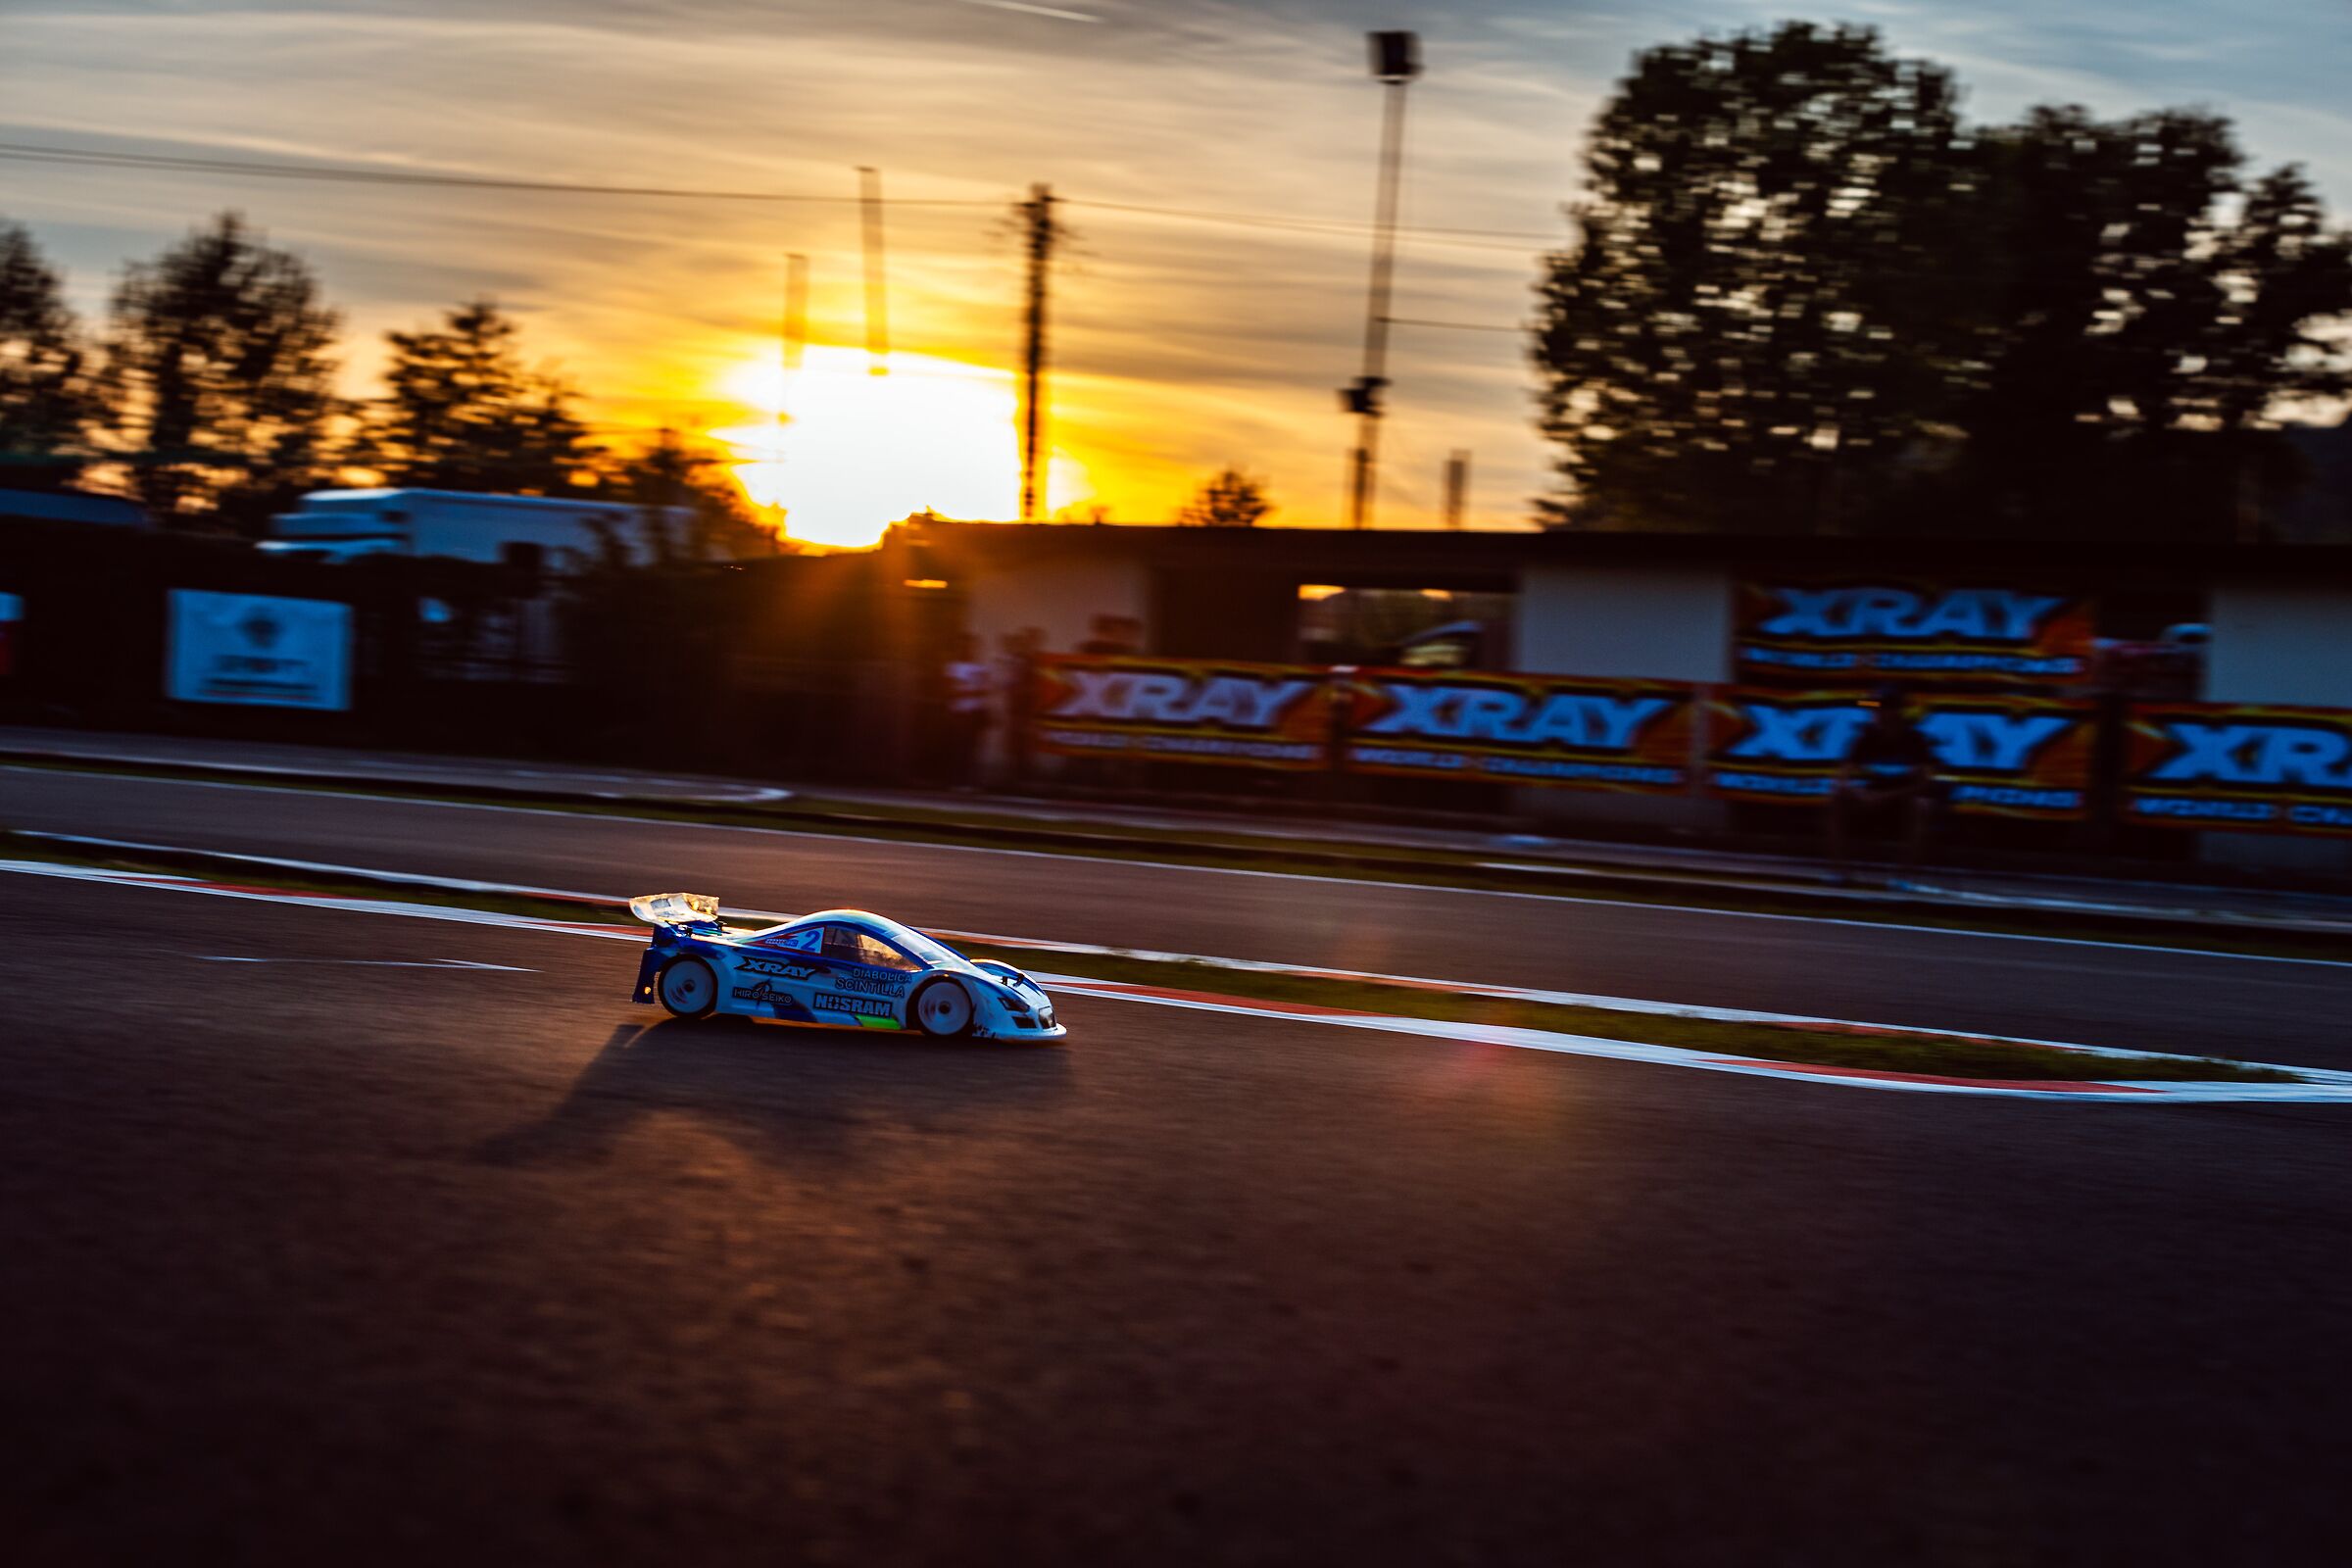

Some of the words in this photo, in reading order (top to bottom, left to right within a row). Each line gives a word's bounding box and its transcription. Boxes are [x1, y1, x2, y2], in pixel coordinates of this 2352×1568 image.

[1759, 590, 2068, 639] XRAY
[1052, 670, 1313, 725] XRAY
[1364, 684, 1674, 749] XRAY
[2148, 721, 2352, 789] XR
[801, 930, 820, 952] 2
[741, 958, 817, 979] XRAY
[852, 967, 912, 982] DIABOLICA
[835, 978, 905, 998] SCINTILLA
[814, 994, 892, 1016] NOSRAM
